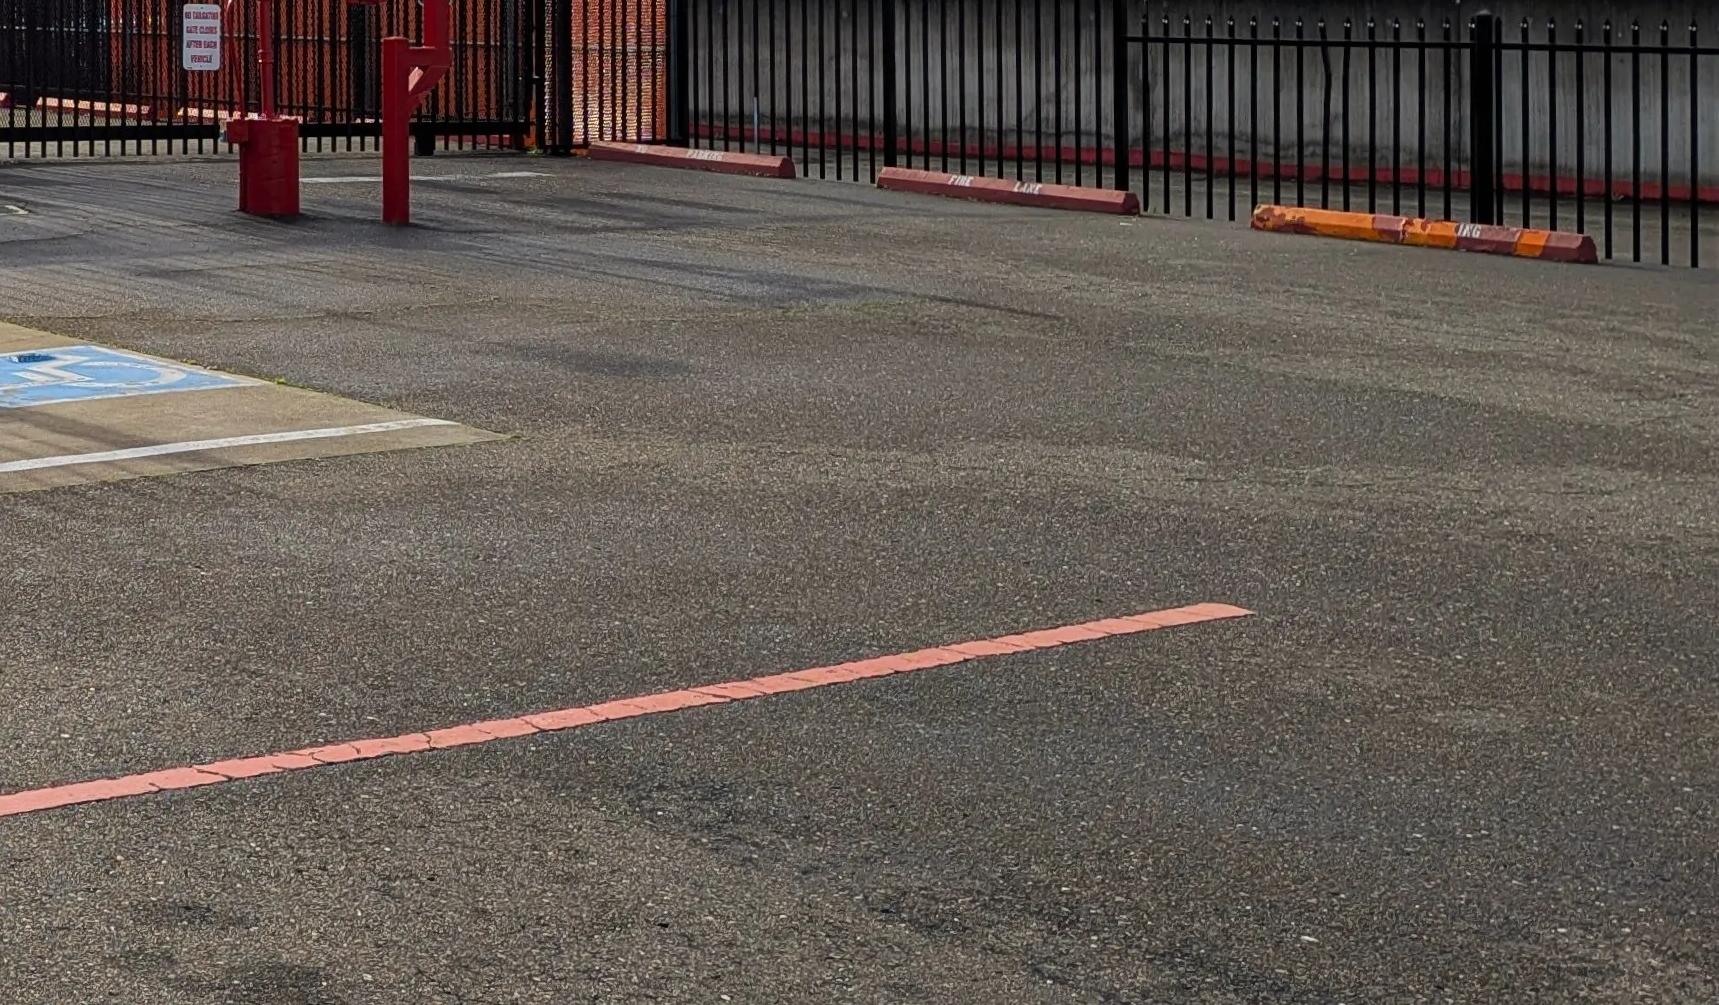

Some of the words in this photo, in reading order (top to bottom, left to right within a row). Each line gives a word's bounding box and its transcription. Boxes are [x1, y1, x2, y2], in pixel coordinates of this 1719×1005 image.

[186, 39, 202, 49] AFTER
[203, 40, 218, 50] EACH
[685, 148, 725, 162] PARKING
[947, 174, 975, 188] FIRE
[1012, 181, 1043, 195] LANE
